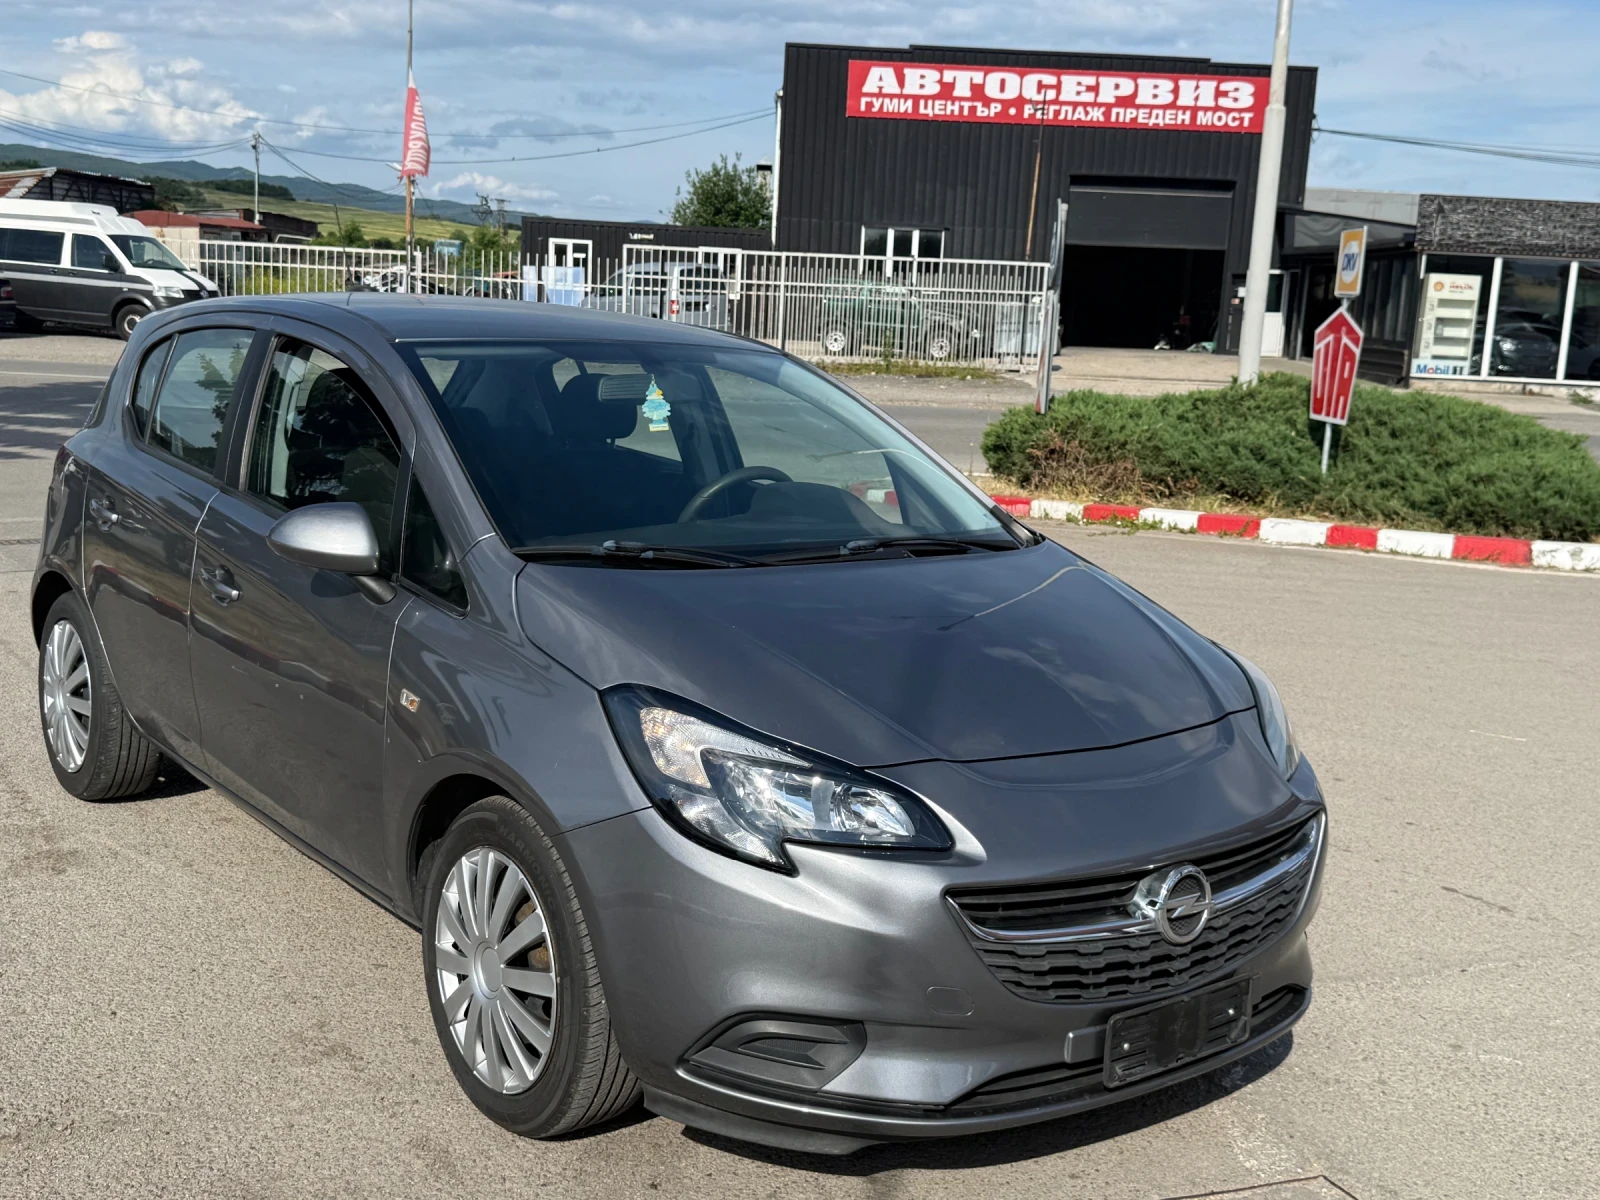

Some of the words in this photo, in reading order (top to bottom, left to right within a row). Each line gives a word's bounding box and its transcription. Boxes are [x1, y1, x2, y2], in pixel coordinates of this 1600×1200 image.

[861, 66, 1256, 109] АВТОСЕРВИЗ
[860, 97, 913, 113] ГУМИ
[919, 99, 1002, 118] ЦЕНТЪР
[1023, 104, 1105, 122] РЕГЛАЖ
[1110, 107, 1192, 126] ПРЕДЕН
[1196, 111, 1254, 127] МОСТ
[1341, 252, 1359, 272] DKV
[1415, 364, 1450, 375] Mobil
